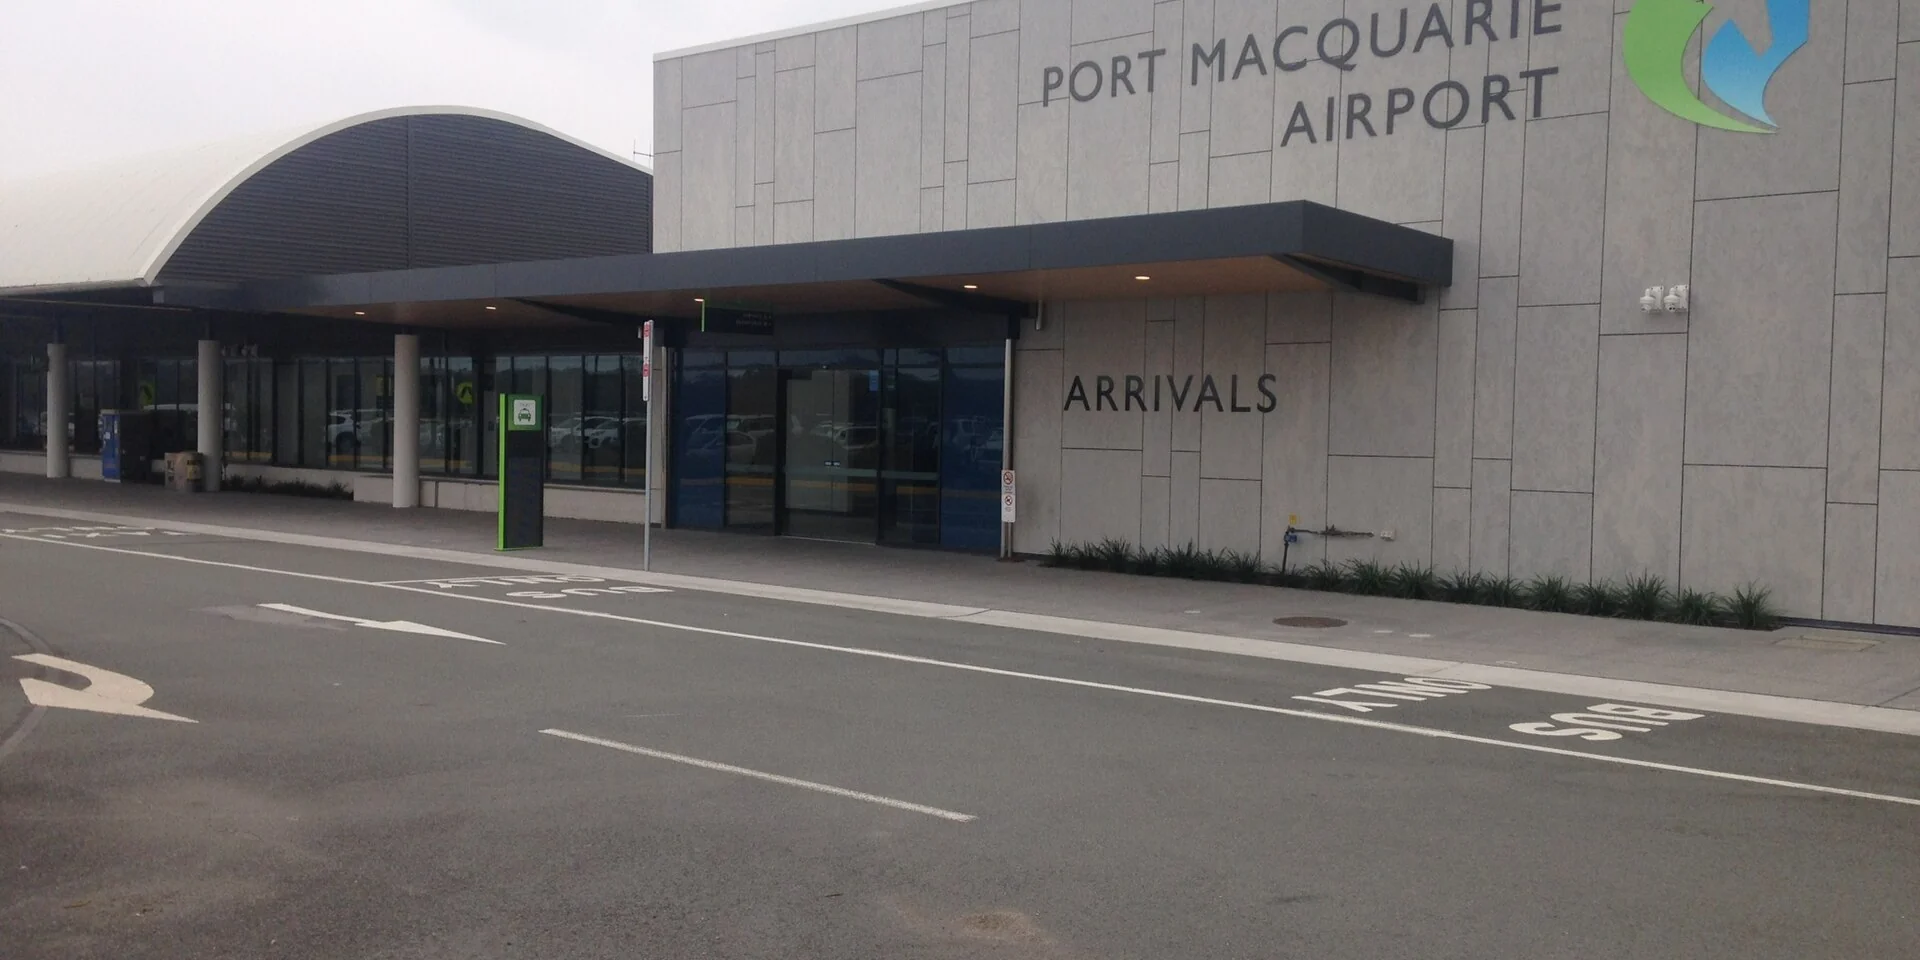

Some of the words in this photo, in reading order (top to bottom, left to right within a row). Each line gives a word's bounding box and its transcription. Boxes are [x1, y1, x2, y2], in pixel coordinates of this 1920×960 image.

[1043, 48, 1166, 107] PORT
[1191, 0, 1562, 86] MACQUARIE
[1280, 66, 1559, 147] AIRPORT
[1063, 373, 1277, 413] ARRIVALS
[424, 575, 605, 588] ONLY
[506, 586, 675, 599] BUS
[1291, 677, 1492, 712] ONLY
[1509, 703, 1705, 741] BUS
